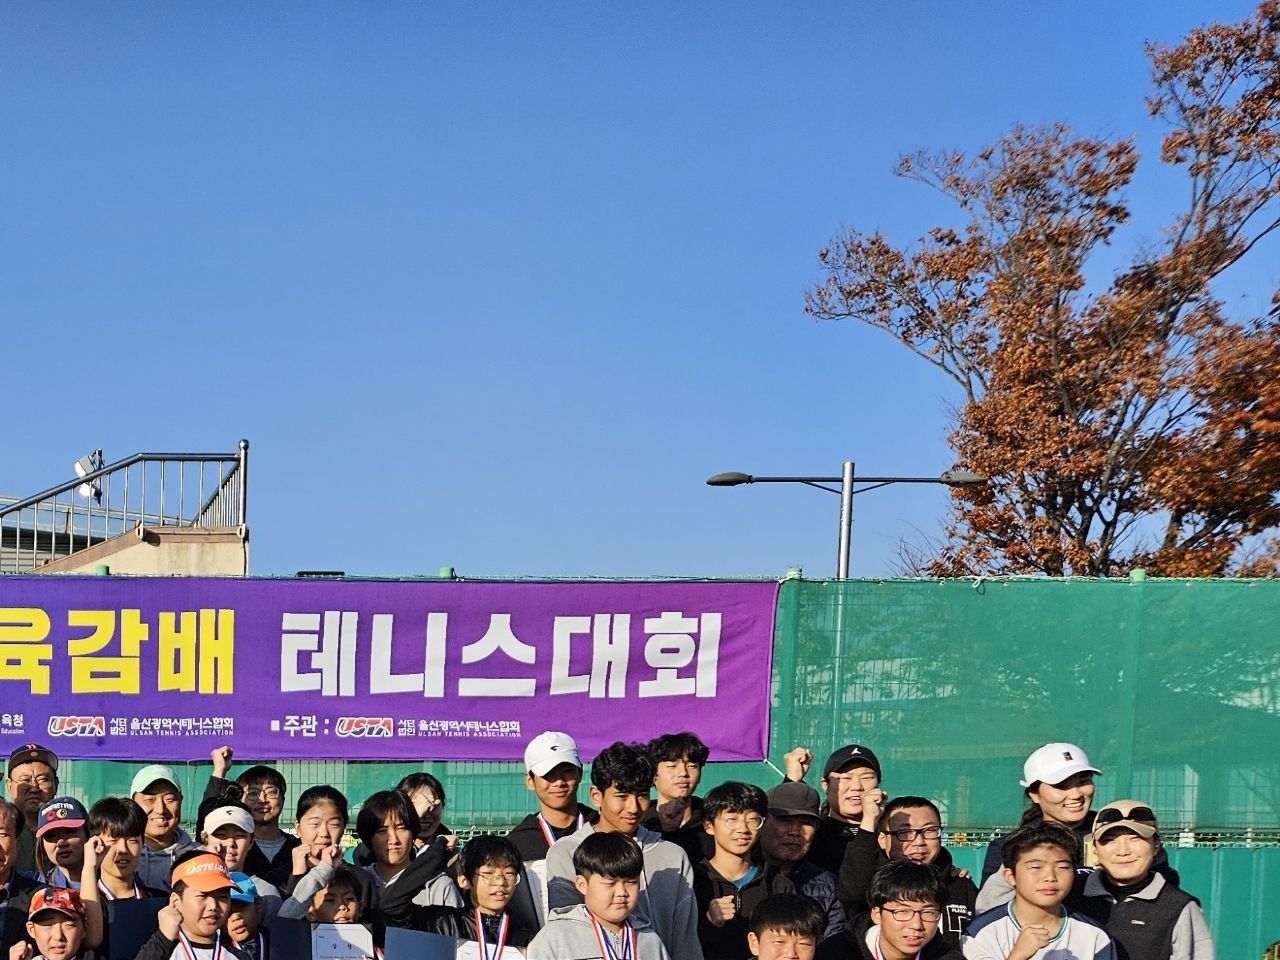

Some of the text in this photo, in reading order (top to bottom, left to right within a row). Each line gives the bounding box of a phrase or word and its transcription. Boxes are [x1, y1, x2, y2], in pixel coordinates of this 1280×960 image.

[281, 611, 722, 699] 테니스대회
[48, 715, 106, 737] USTA
[130, 717, 234, 731] 울산광역시테니스협회
[283, 715, 318, 737] 주관
[335, 717, 394, 738] USTA
[419, 720, 521, 733] 울산광역시테니스협회
